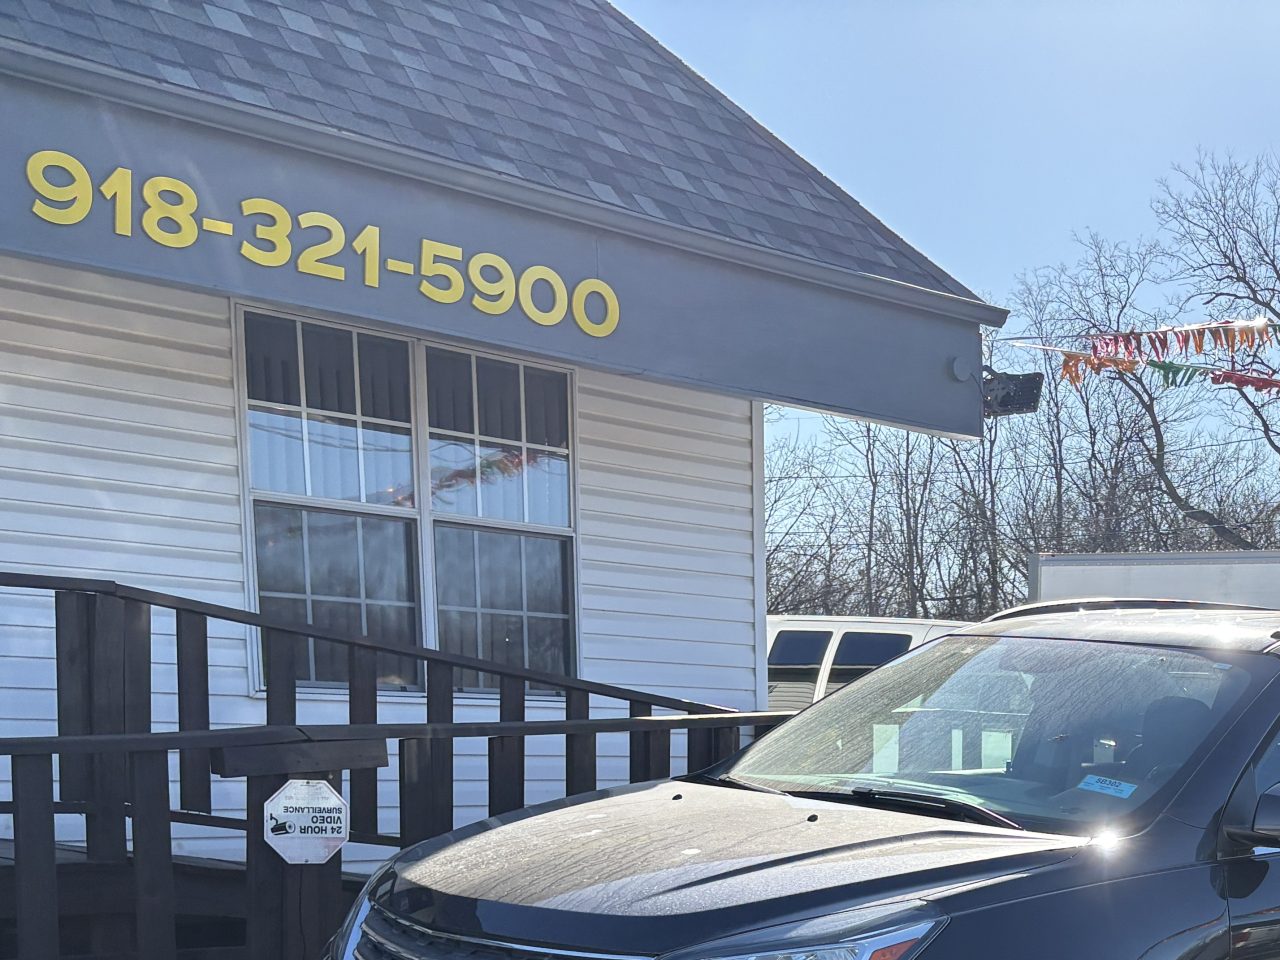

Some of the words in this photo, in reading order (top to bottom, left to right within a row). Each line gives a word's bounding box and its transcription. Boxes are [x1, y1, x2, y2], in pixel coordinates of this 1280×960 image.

[26, 150, 620, 337] 918-321-5900
[283, 806, 342, 814] SURVEILLANCE
[311, 815, 342, 824] VIDEO
[300, 826, 327, 834] HOUR
[331, 826, 342, 834] 24
